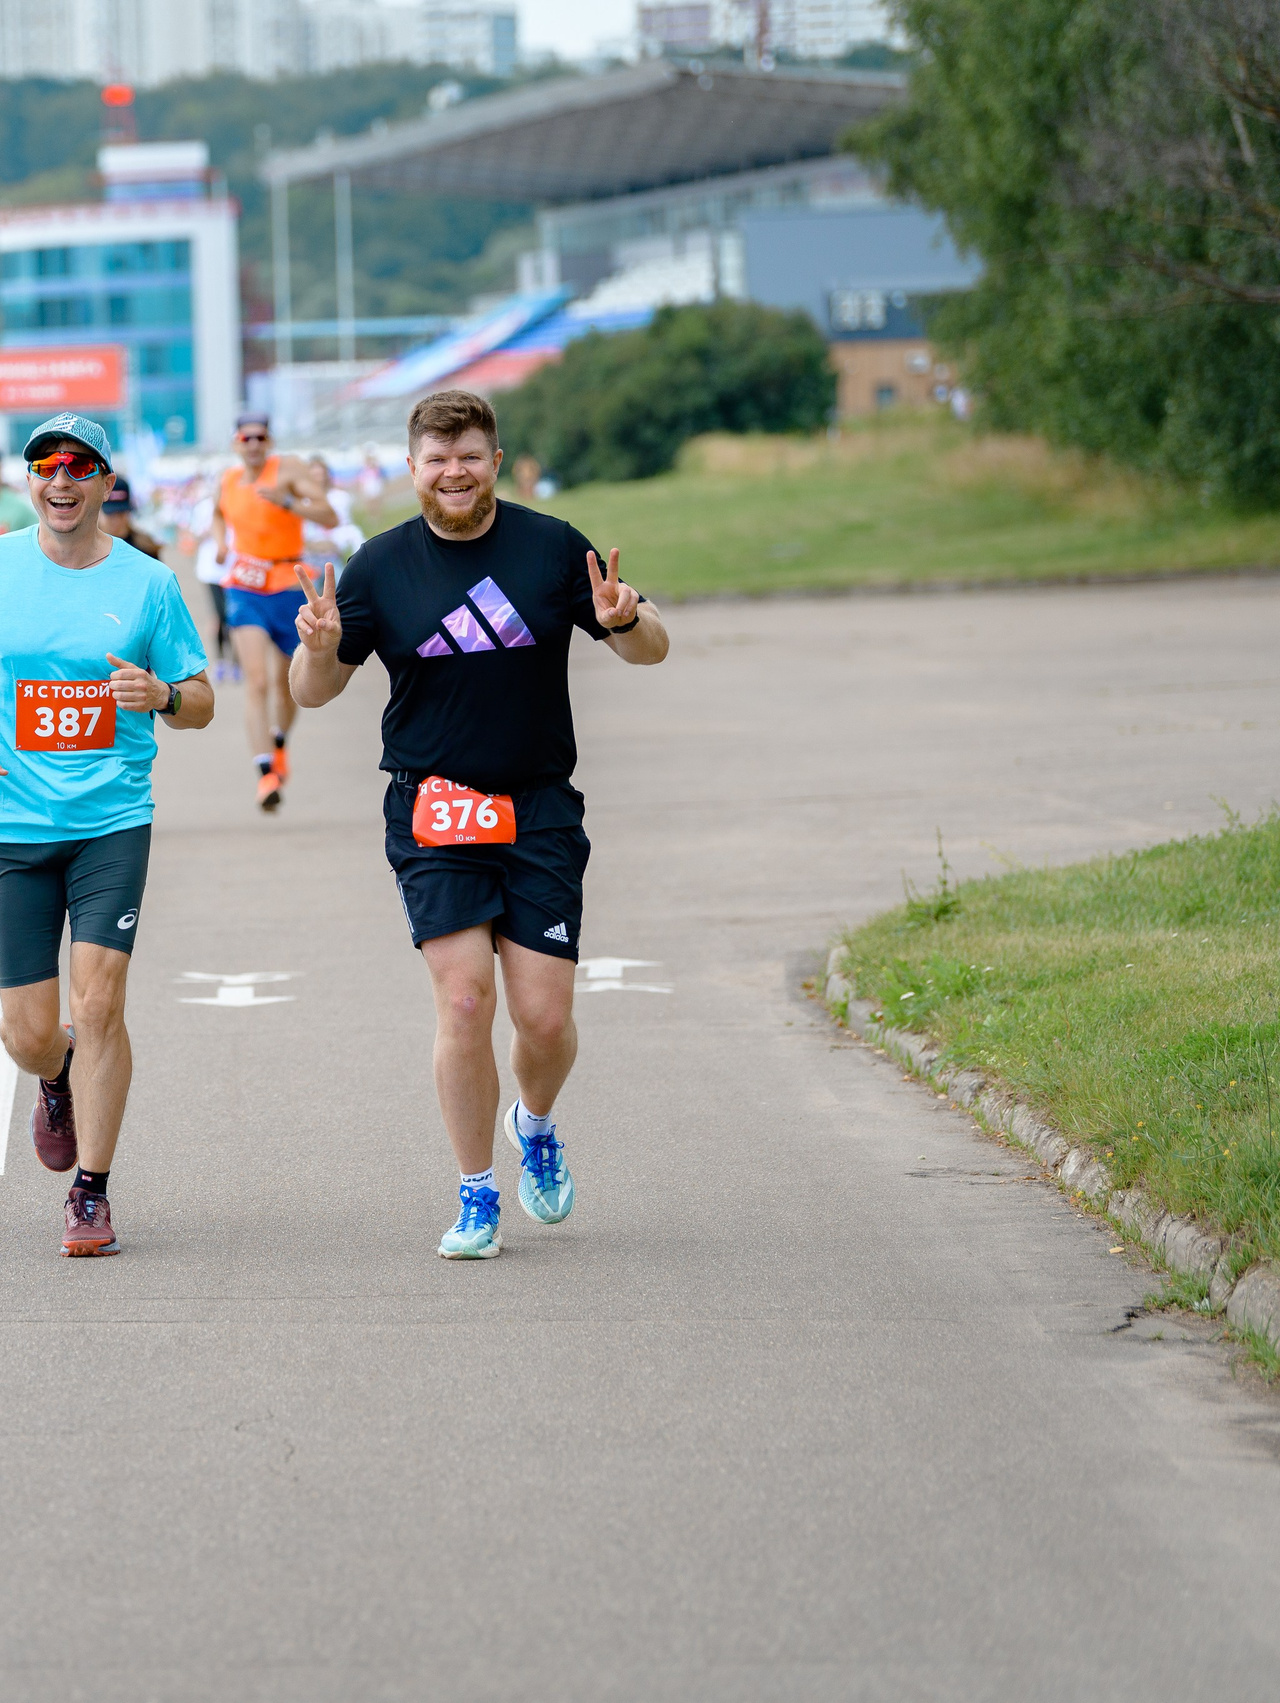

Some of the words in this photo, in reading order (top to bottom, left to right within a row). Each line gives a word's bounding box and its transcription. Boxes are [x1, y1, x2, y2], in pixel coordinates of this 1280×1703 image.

[23, 684, 34, 698] Я
[37, 685, 49, 698] С
[51, 682, 110, 699] ТОБОЙ
[34, 706, 102, 738] 387
[430, 780, 442, 793] С
[430, 797, 499, 831] 376
[455, 834, 464, 842] 10
[543, 930, 569, 943] adidas
